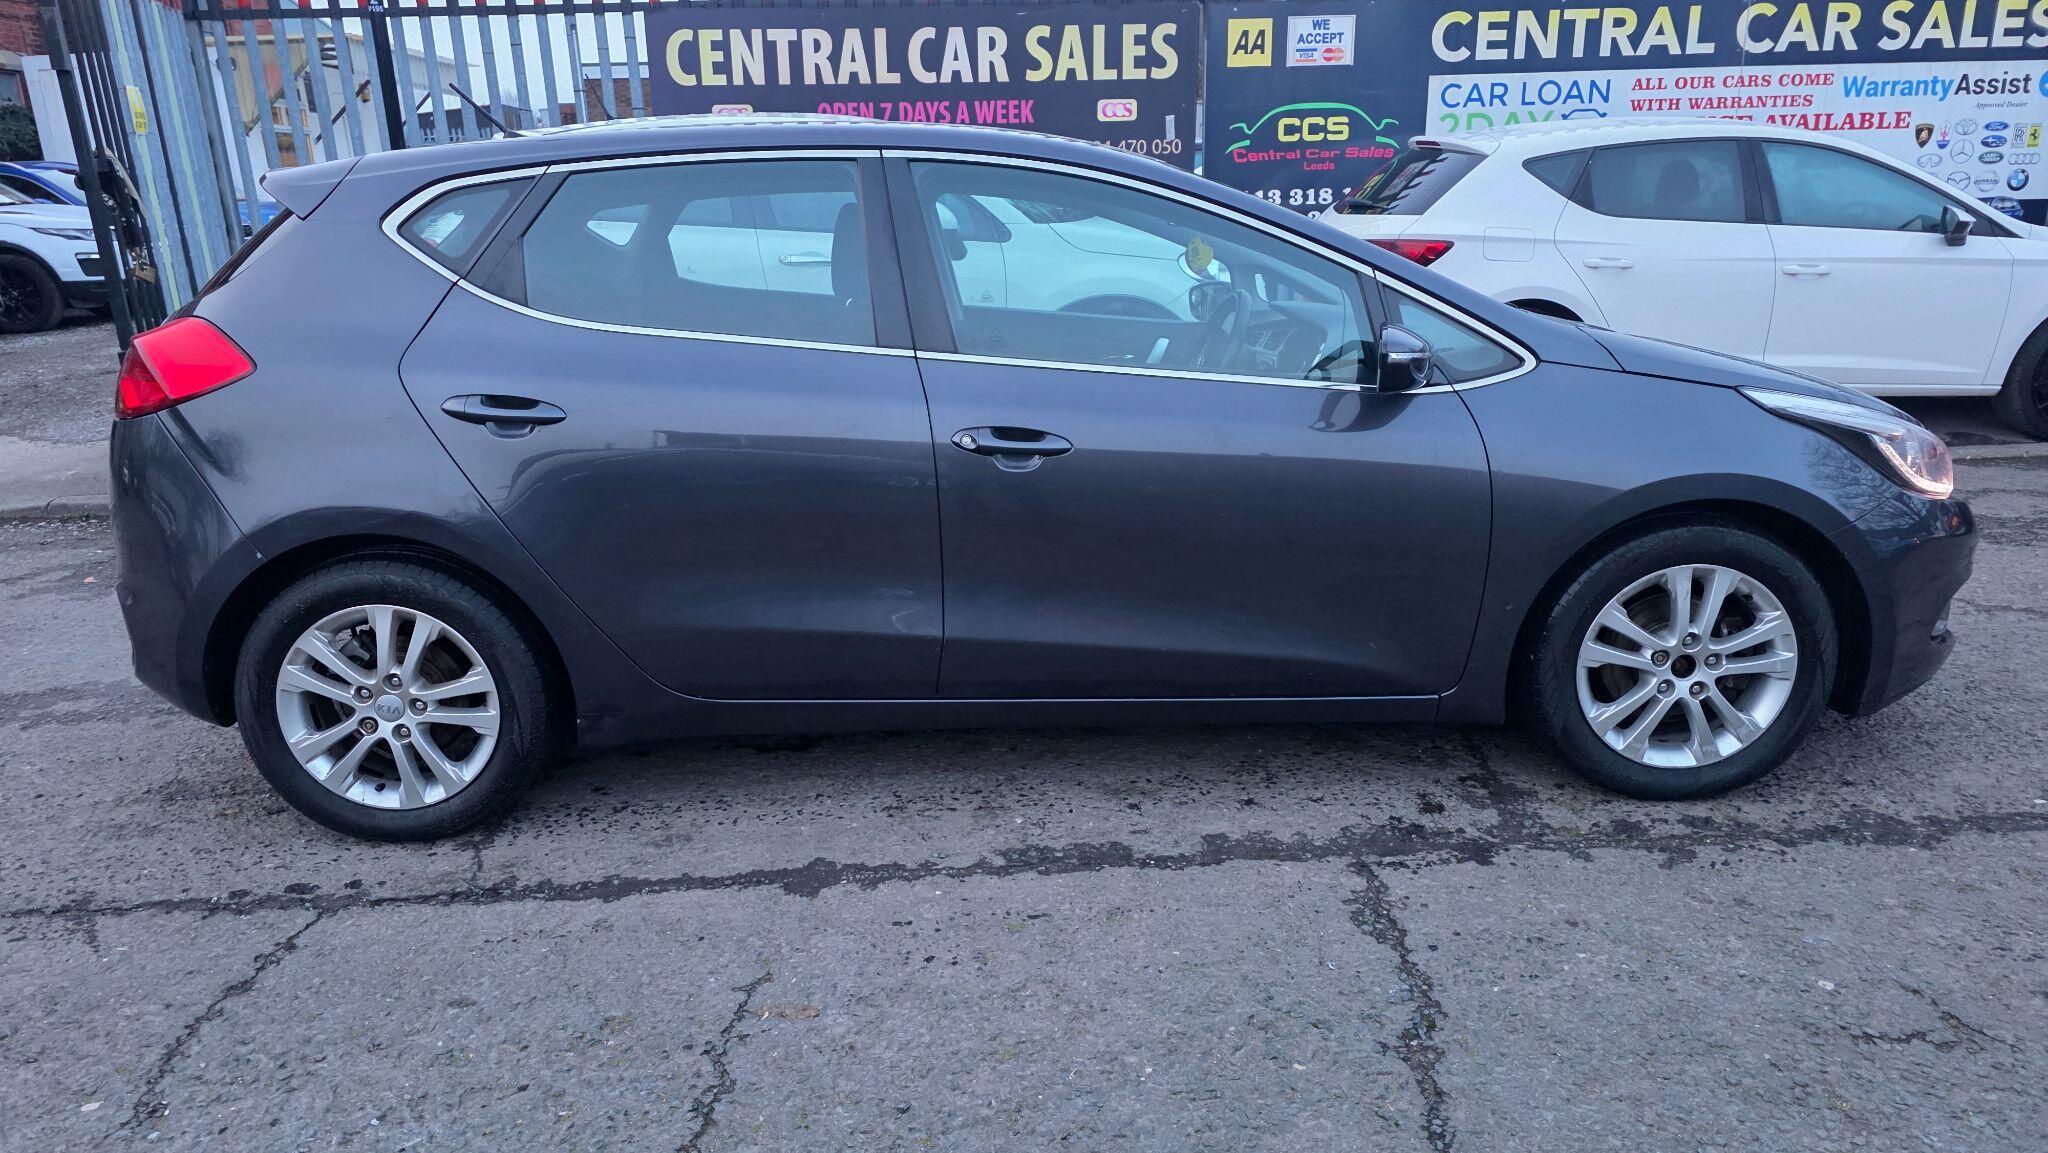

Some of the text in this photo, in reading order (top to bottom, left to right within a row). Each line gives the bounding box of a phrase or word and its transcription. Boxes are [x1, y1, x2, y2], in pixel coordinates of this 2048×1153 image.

[1312, 19, 1331, 31] WE
[1432, 5, 1715, 62] CENTRAL
[1736, 2, 1861, 54] CAR
[1232, 29, 1266, 55] AA
[1297, 32, 1345, 45] ACCEPT
[666, 22, 1179, 86] CENTRAL CAR SALES
[1632, 73, 1834, 91] ALL OUR CARS COME
[1842, 71, 2032, 102] WarrantyAssist
[1441, 79, 1611, 108] CAR LOAN
[817, 99, 1035, 123] OPEN 7 DAYS A WEEK
[1101, 102, 1133, 117] CCS
[1630, 94, 1814, 111] WITH WARRANTIES
[1976, 101, 2005, 110] Approved
[1277, 116, 1349, 142] CCS
[1152, 139, 1181, 154] 050
[1233, 146, 1394, 163] Central Car Sales
[1304, 162, 1335, 171] Leeds
[1289, 187, 1333, 205] 318
[377, 703, 401, 715] KIA
